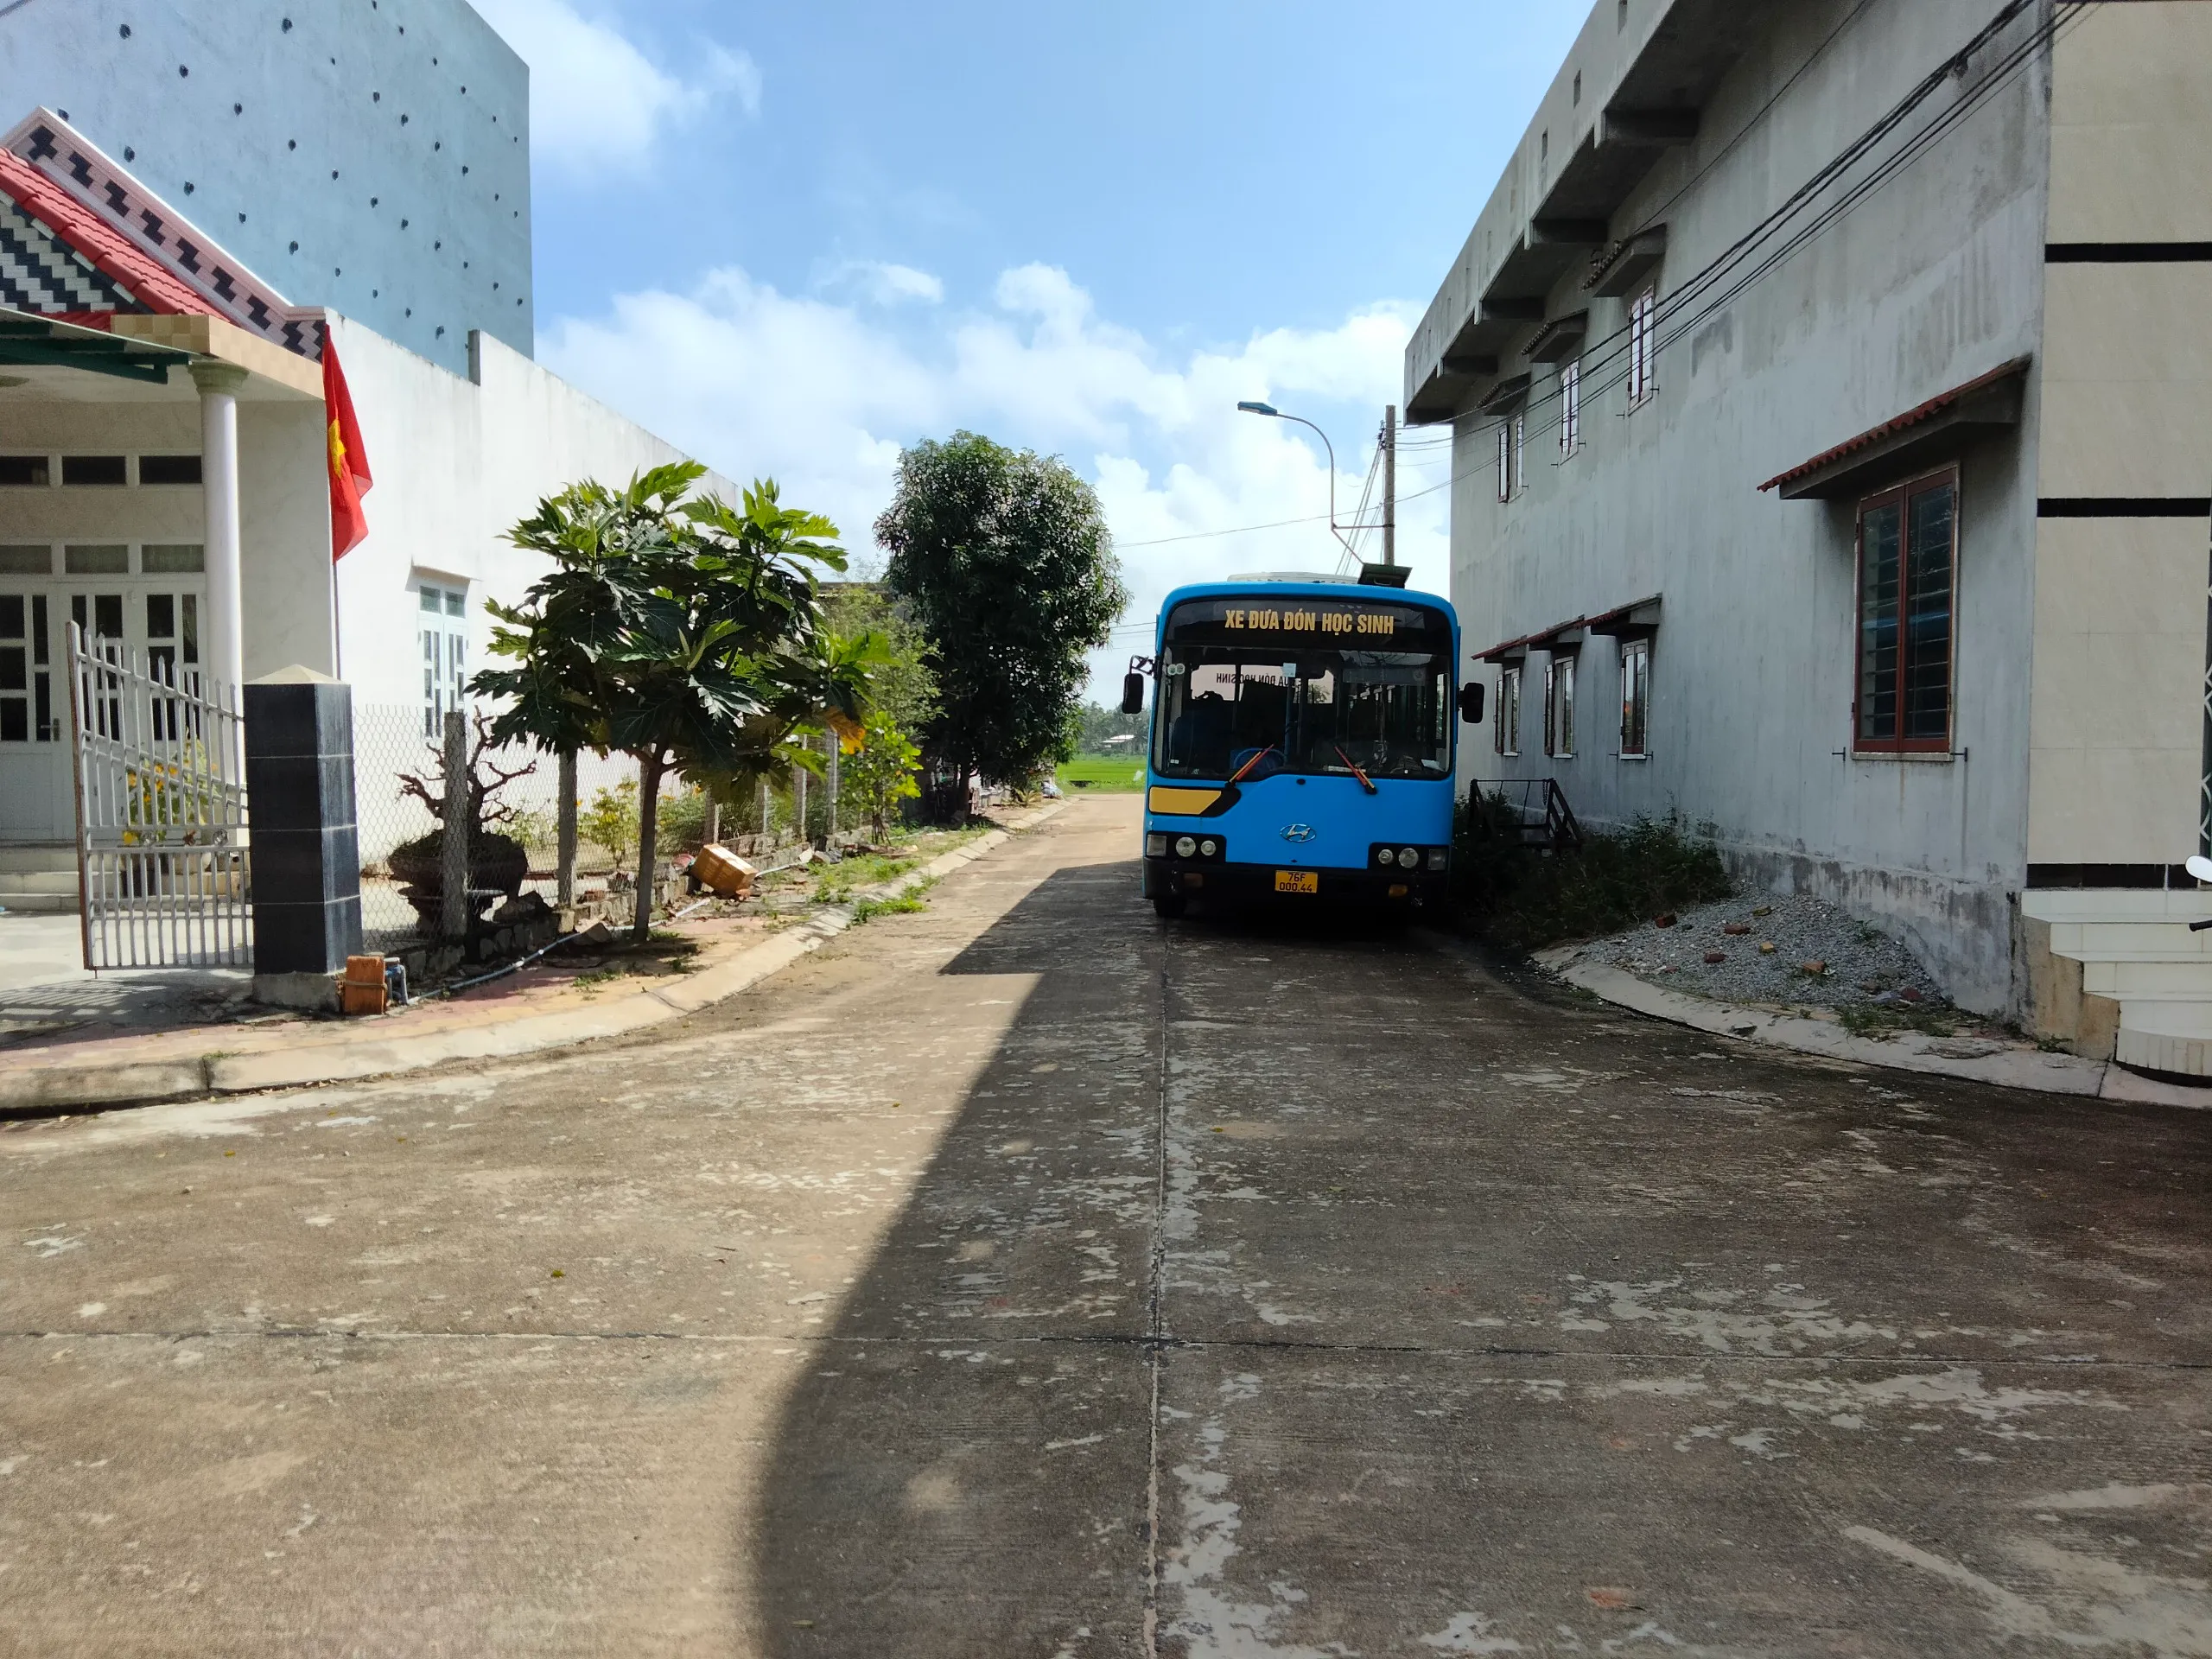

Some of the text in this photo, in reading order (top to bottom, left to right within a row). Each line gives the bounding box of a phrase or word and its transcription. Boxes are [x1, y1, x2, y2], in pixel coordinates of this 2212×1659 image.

[1224, 608, 1394, 636] XE ĐƯA ĐÓN HỌC SINH
[1288, 873, 1306, 882] 76F
[1279, 882, 1313, 892] 000.44
